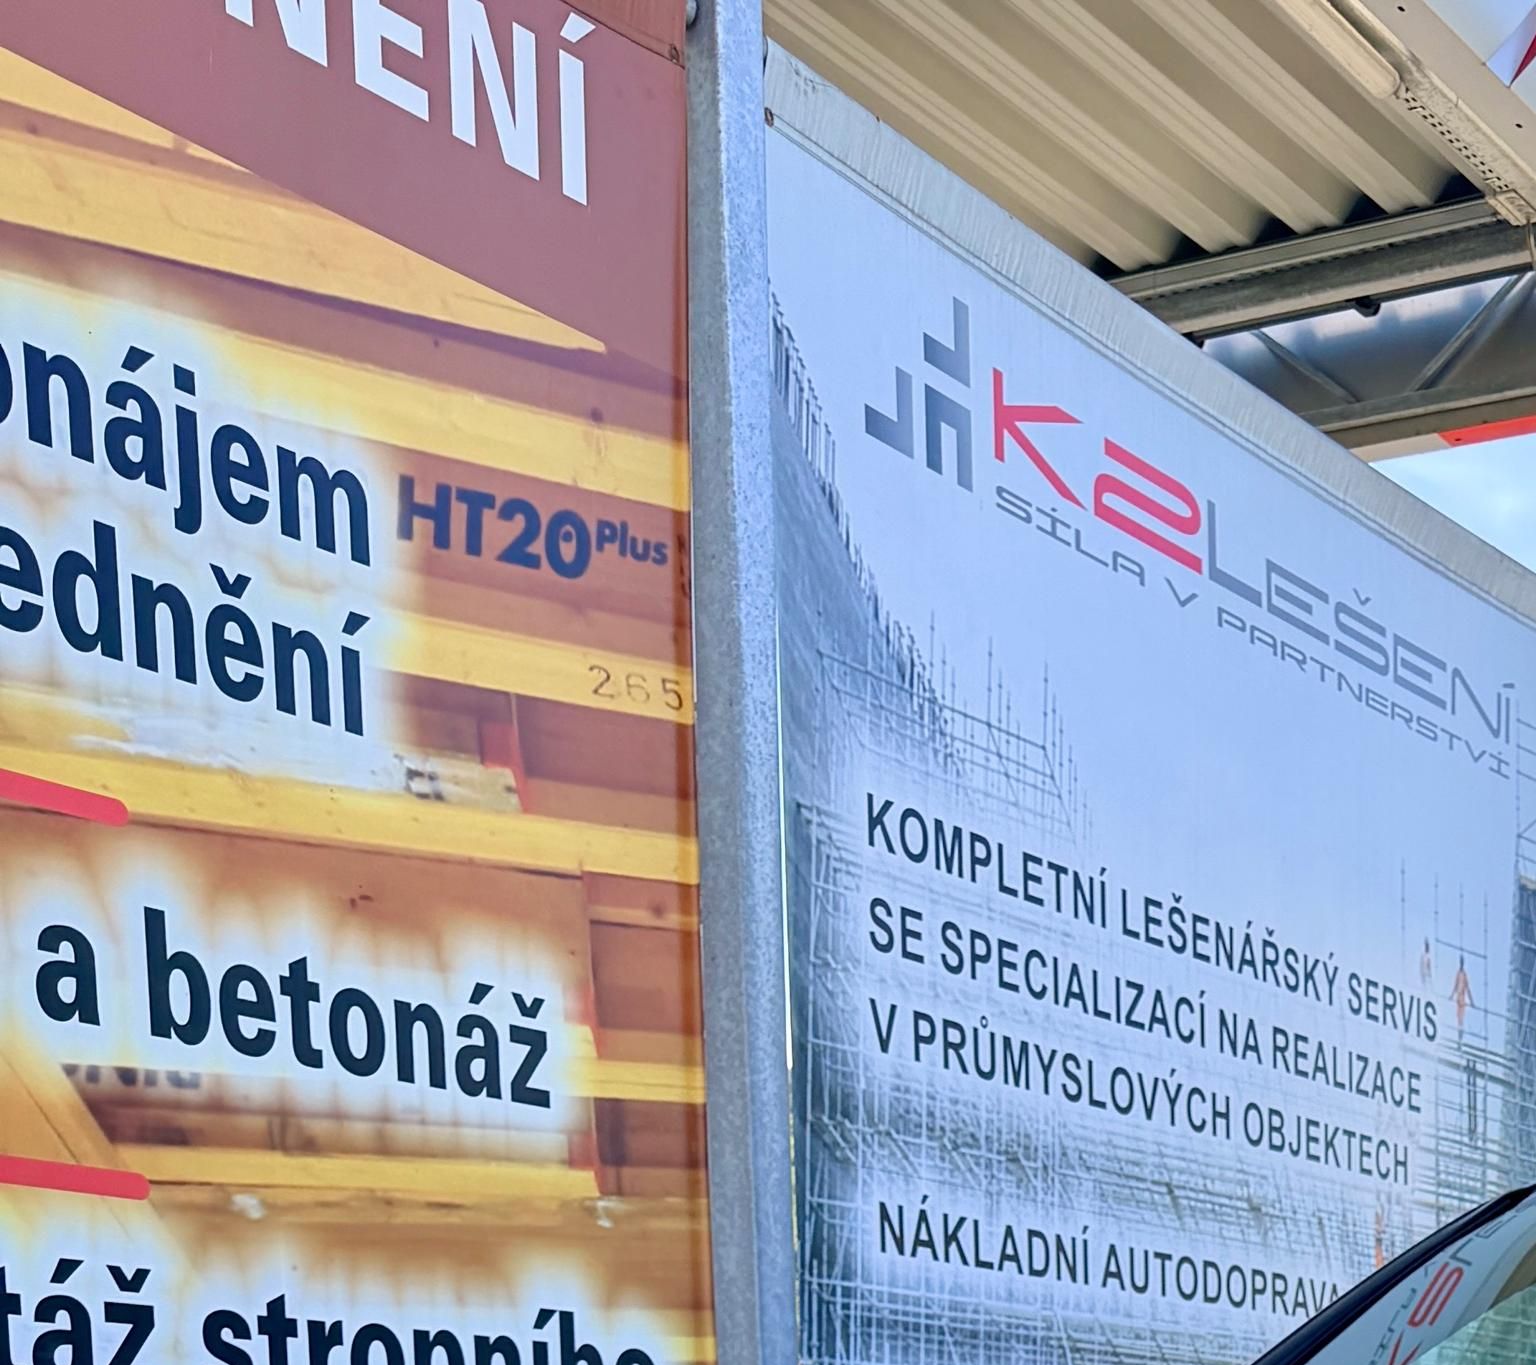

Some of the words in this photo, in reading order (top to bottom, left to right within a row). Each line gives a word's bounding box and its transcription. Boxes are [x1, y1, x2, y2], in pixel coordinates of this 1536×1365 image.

[0, 343, 371, 567] nájem
[588, 664, 684, 712] 265
[994, 484, 1146, 587] SÍLA
[1163, 575, 1199, 608] V
[1217, 614, 1511, 780] PARTNERSTVÍ
[35, 923, 101, 1027] a
[143, 906, 552, 1110] betonáž
[866, 793, 1108, 928] KOMPLETNÍ
[1121, 891, 1338, 1006] LEŠENÁŘSKÝ
[1347, 972, 1438, 1042] SERVIS
[869, 898, 924, 965] SE
[941, 922, 1207, 1048] SPECIALIZACÍ
[1219, 1009, 1262, 1066] NA
[1272, 1026, 1422, 1114] REALIZACE
[868, 996, 898, 1054] V
[913, 1009, 1231, 1141] PRŮMYSLOVÝCH
[1243, 1102, 1410, 1186] OBJEKTECH
[879, 1199, 1091, 1287] NÁKLADNÍ
